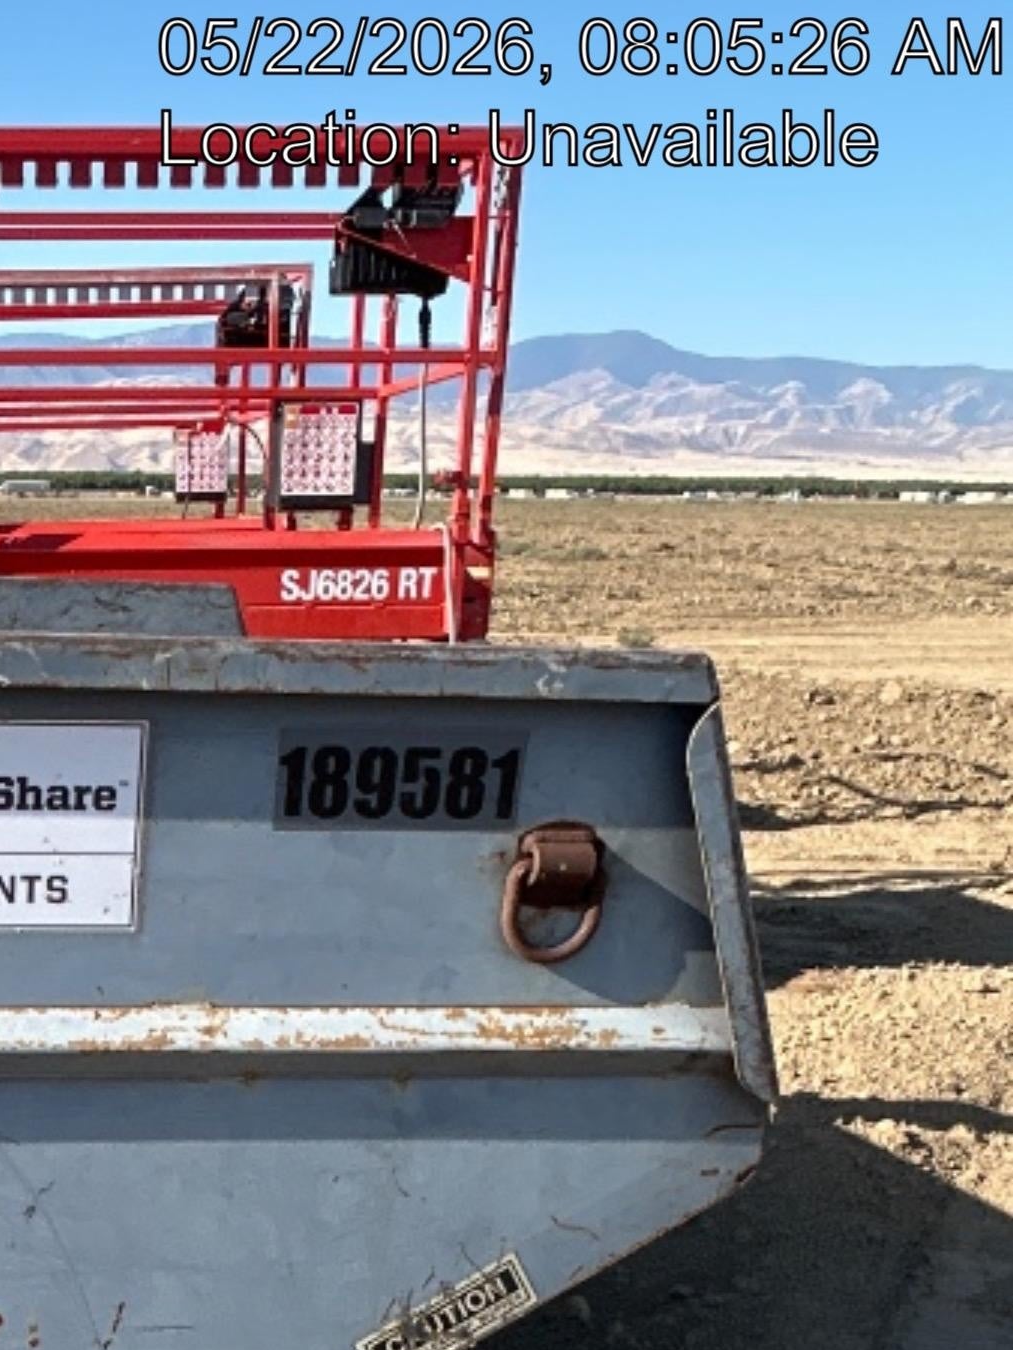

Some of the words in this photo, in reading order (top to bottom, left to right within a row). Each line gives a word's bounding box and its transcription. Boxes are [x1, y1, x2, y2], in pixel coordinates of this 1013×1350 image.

[280, 568, 390, 601] SJ6826
[397, 566, 438, 599] RT
[278, 745, 521, 820] 189581
